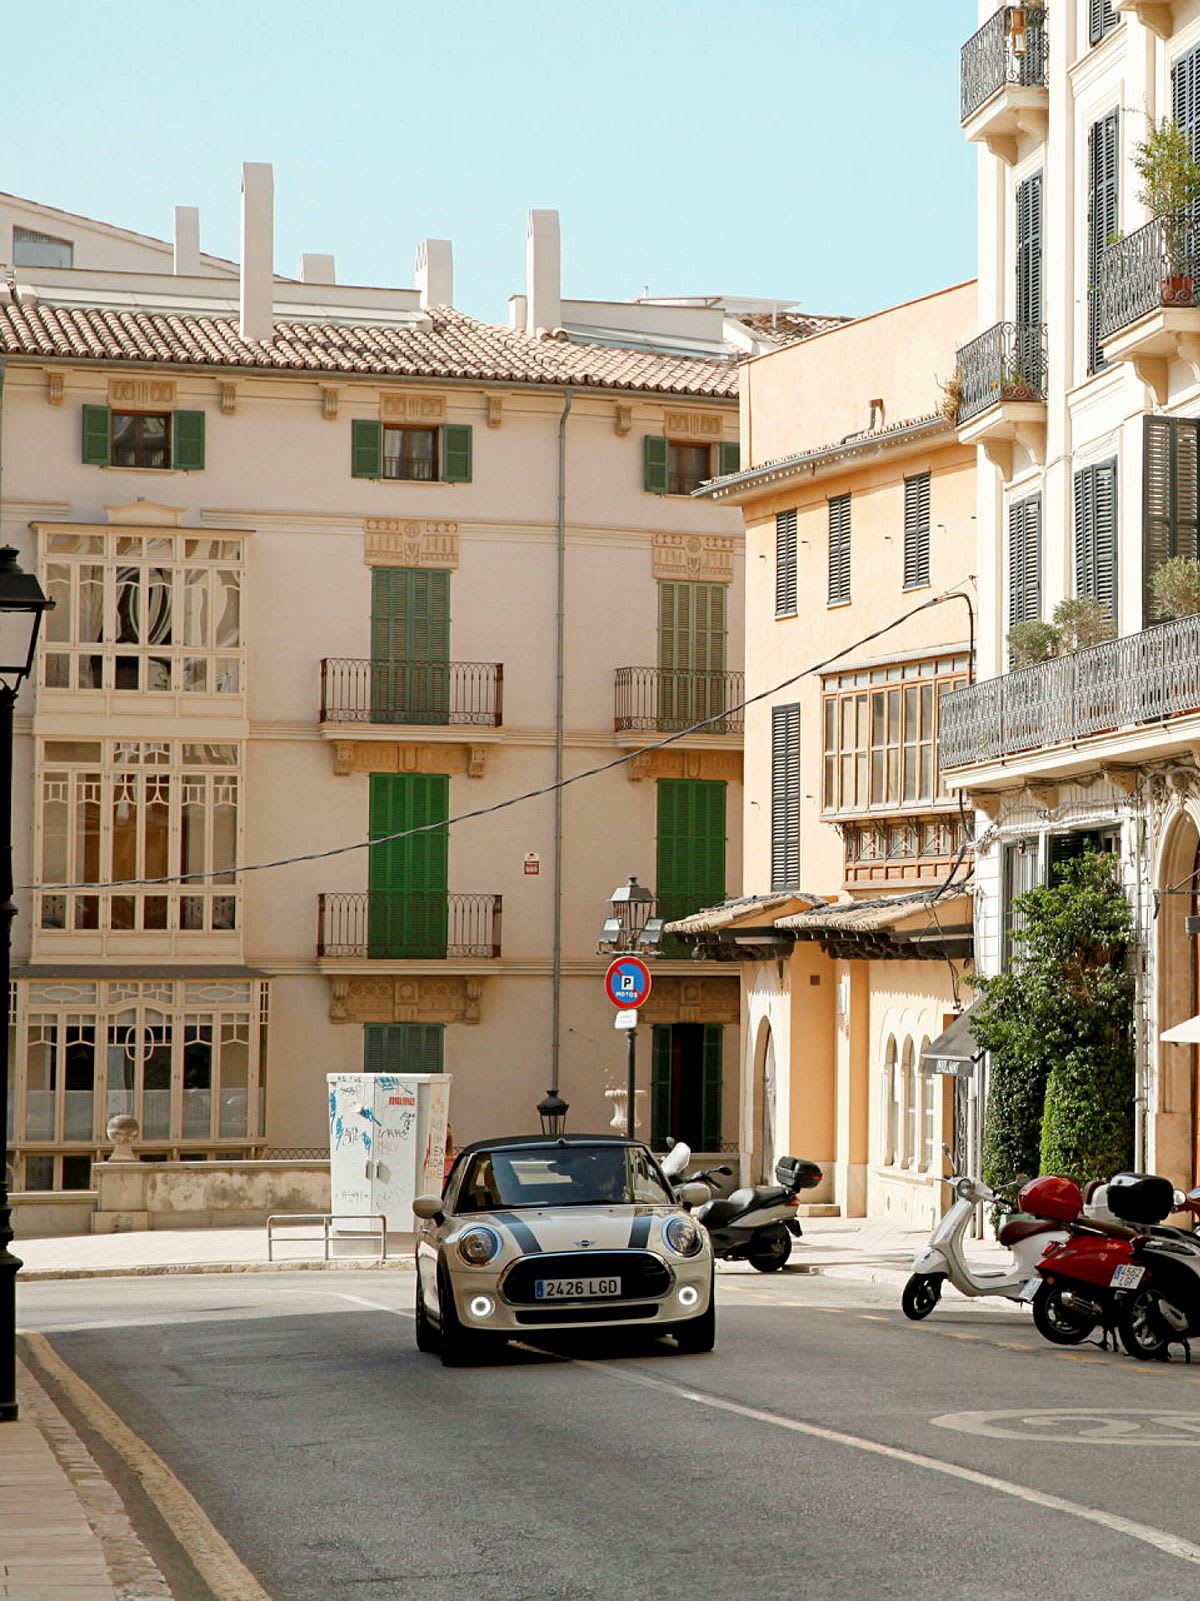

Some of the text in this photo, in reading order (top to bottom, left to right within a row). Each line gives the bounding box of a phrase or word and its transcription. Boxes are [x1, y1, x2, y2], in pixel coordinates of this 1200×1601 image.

[624, 978, 631, 987] P
[546, 1280, 618, 1297] 2426 LGD
